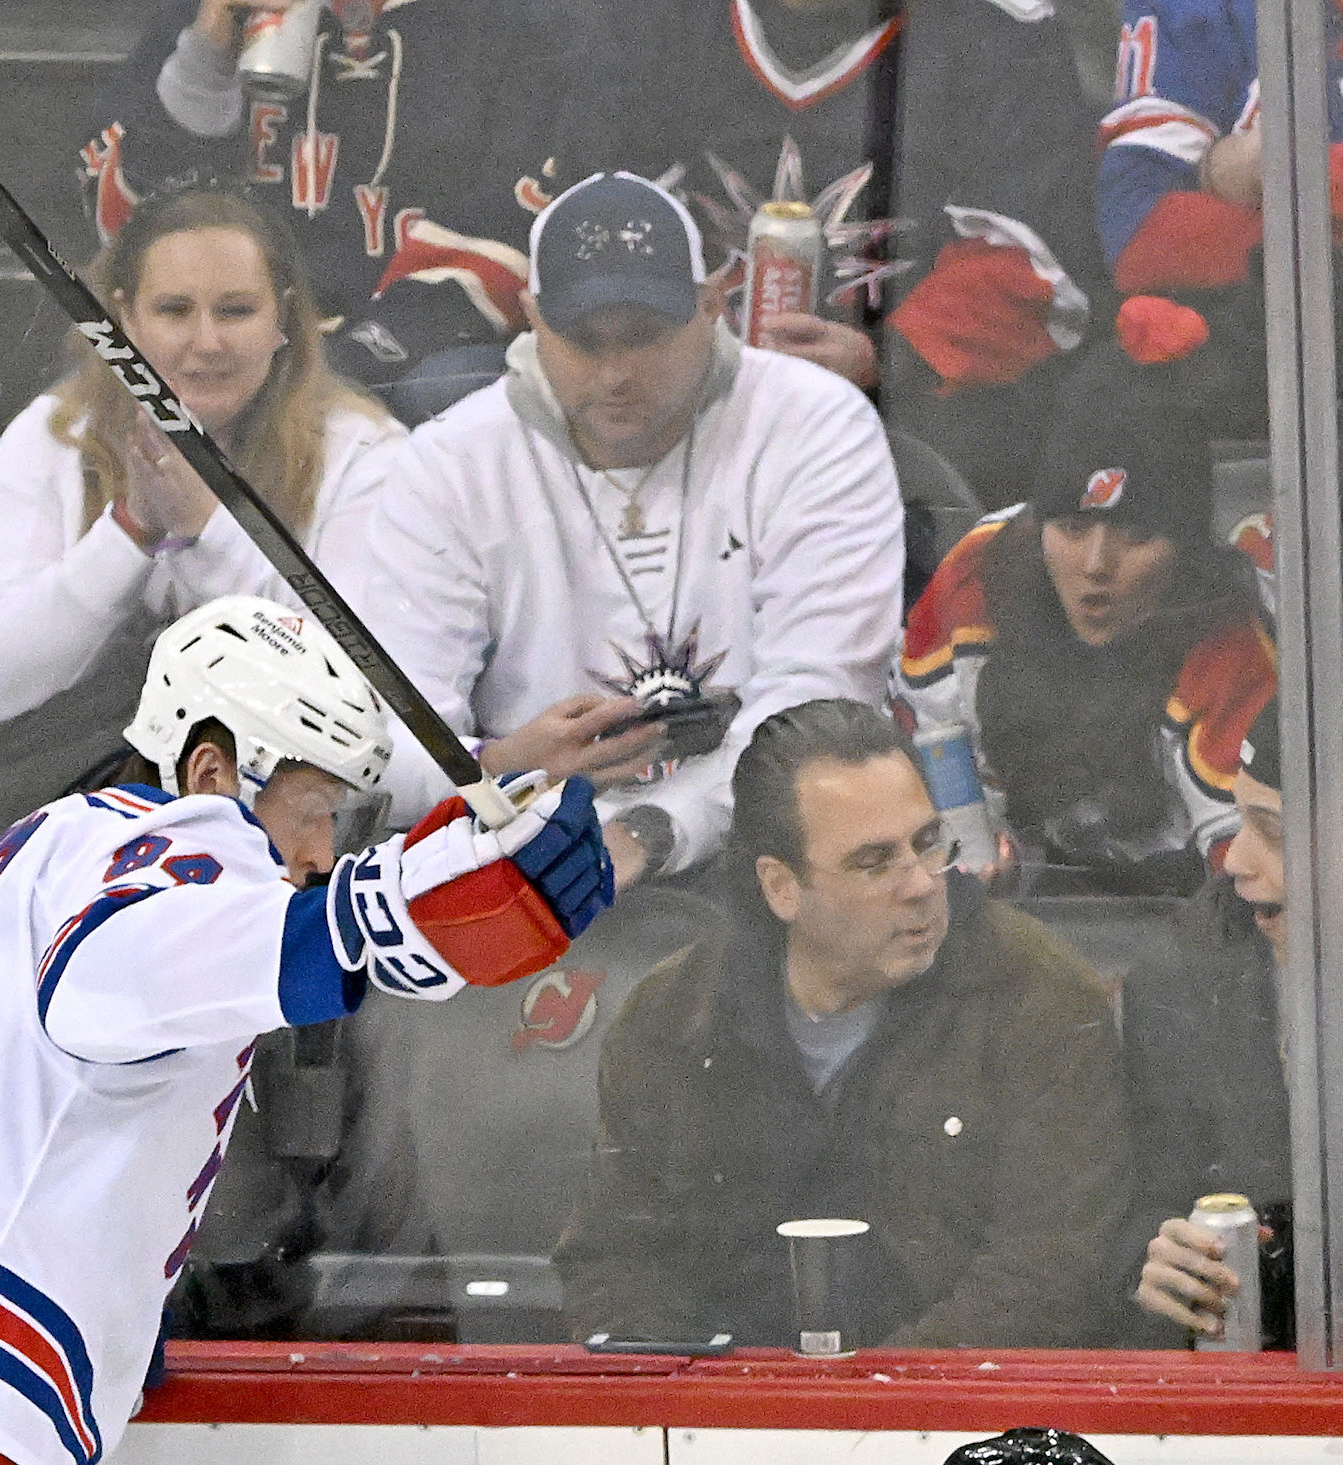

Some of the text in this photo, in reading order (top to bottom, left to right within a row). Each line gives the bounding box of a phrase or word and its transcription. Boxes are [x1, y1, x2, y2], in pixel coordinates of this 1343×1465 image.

[76, 319, 191, 432] CCM
[250, 624, 289, 656] Moore
[253, 612, 307, 655] Benjamin
